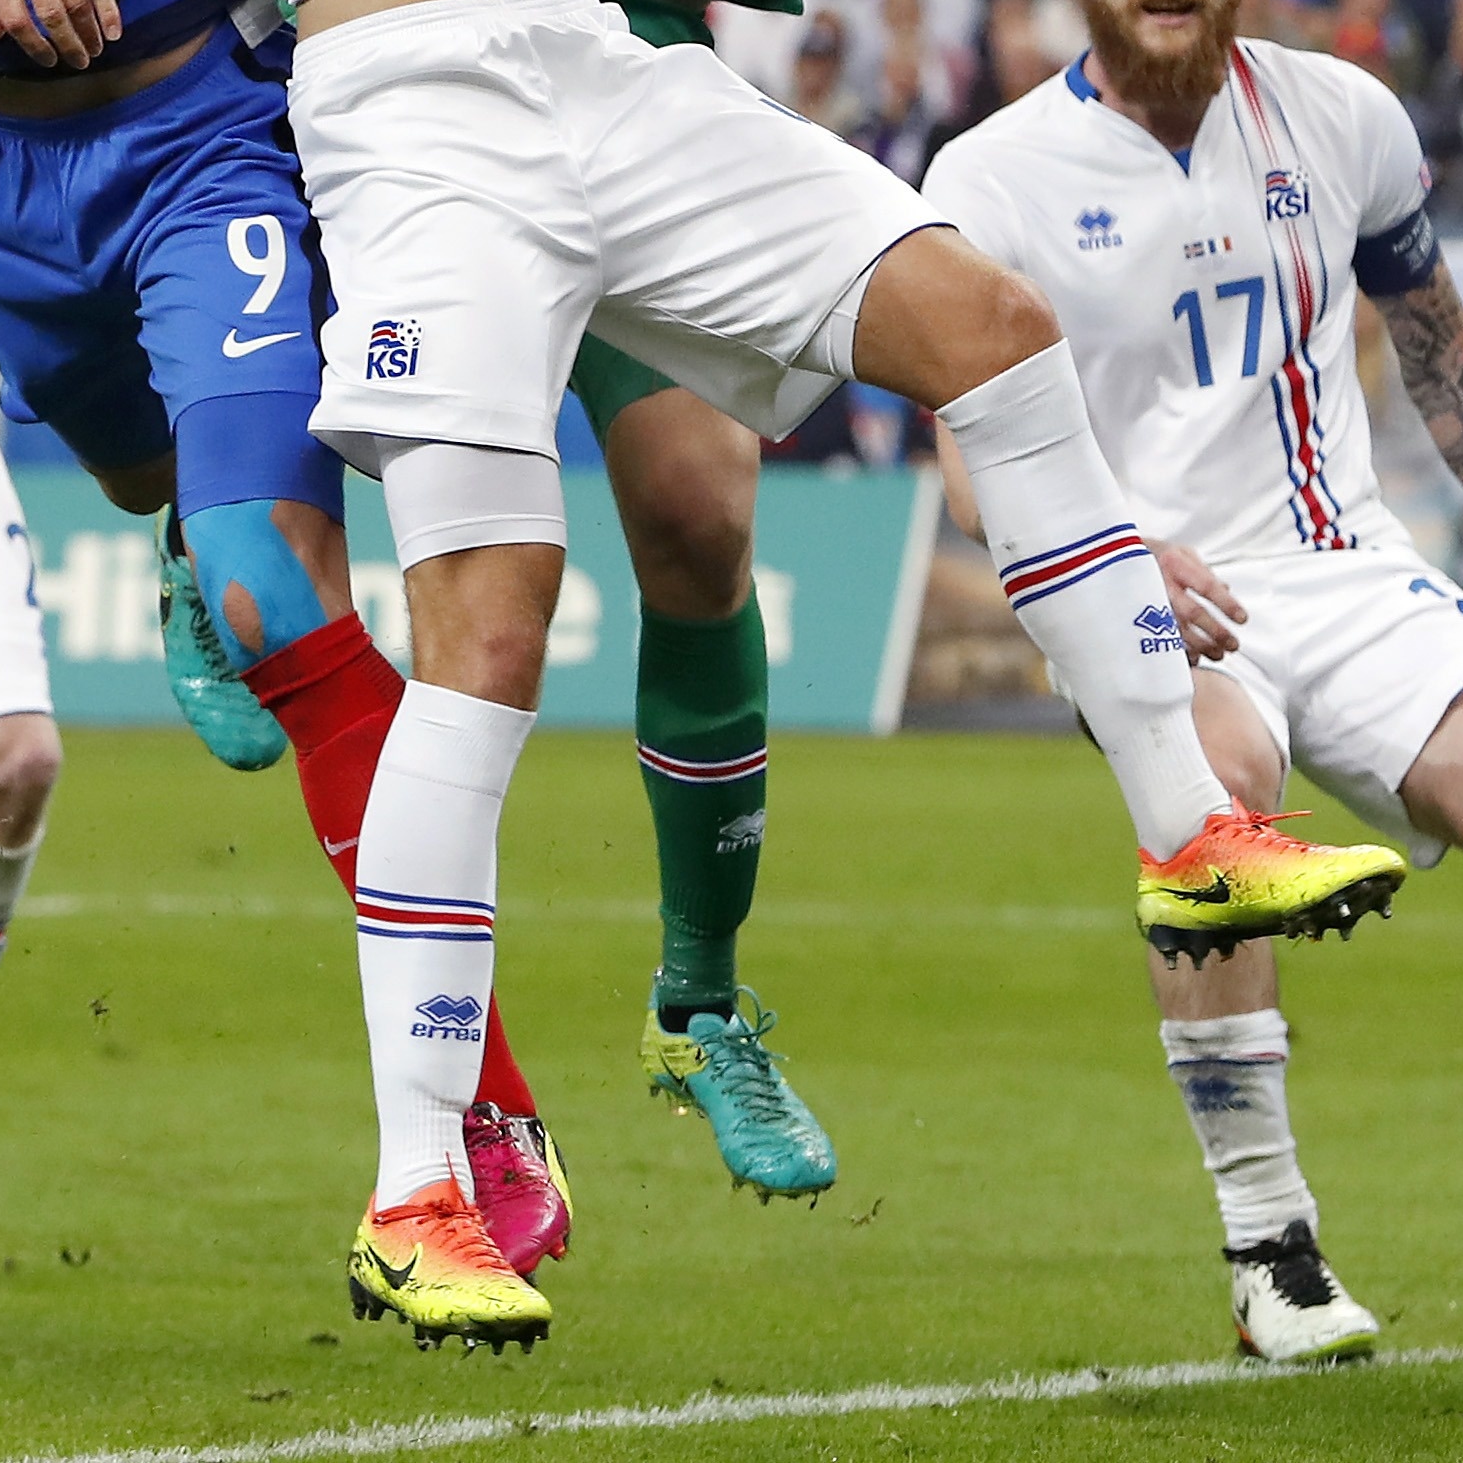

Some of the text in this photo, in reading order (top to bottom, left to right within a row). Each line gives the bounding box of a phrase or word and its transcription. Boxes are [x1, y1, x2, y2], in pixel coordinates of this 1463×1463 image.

[226, 214, 287, 314] 9
[1172, 276, 1265, 388] 17
[410, 1022, 482, 1043] errea
